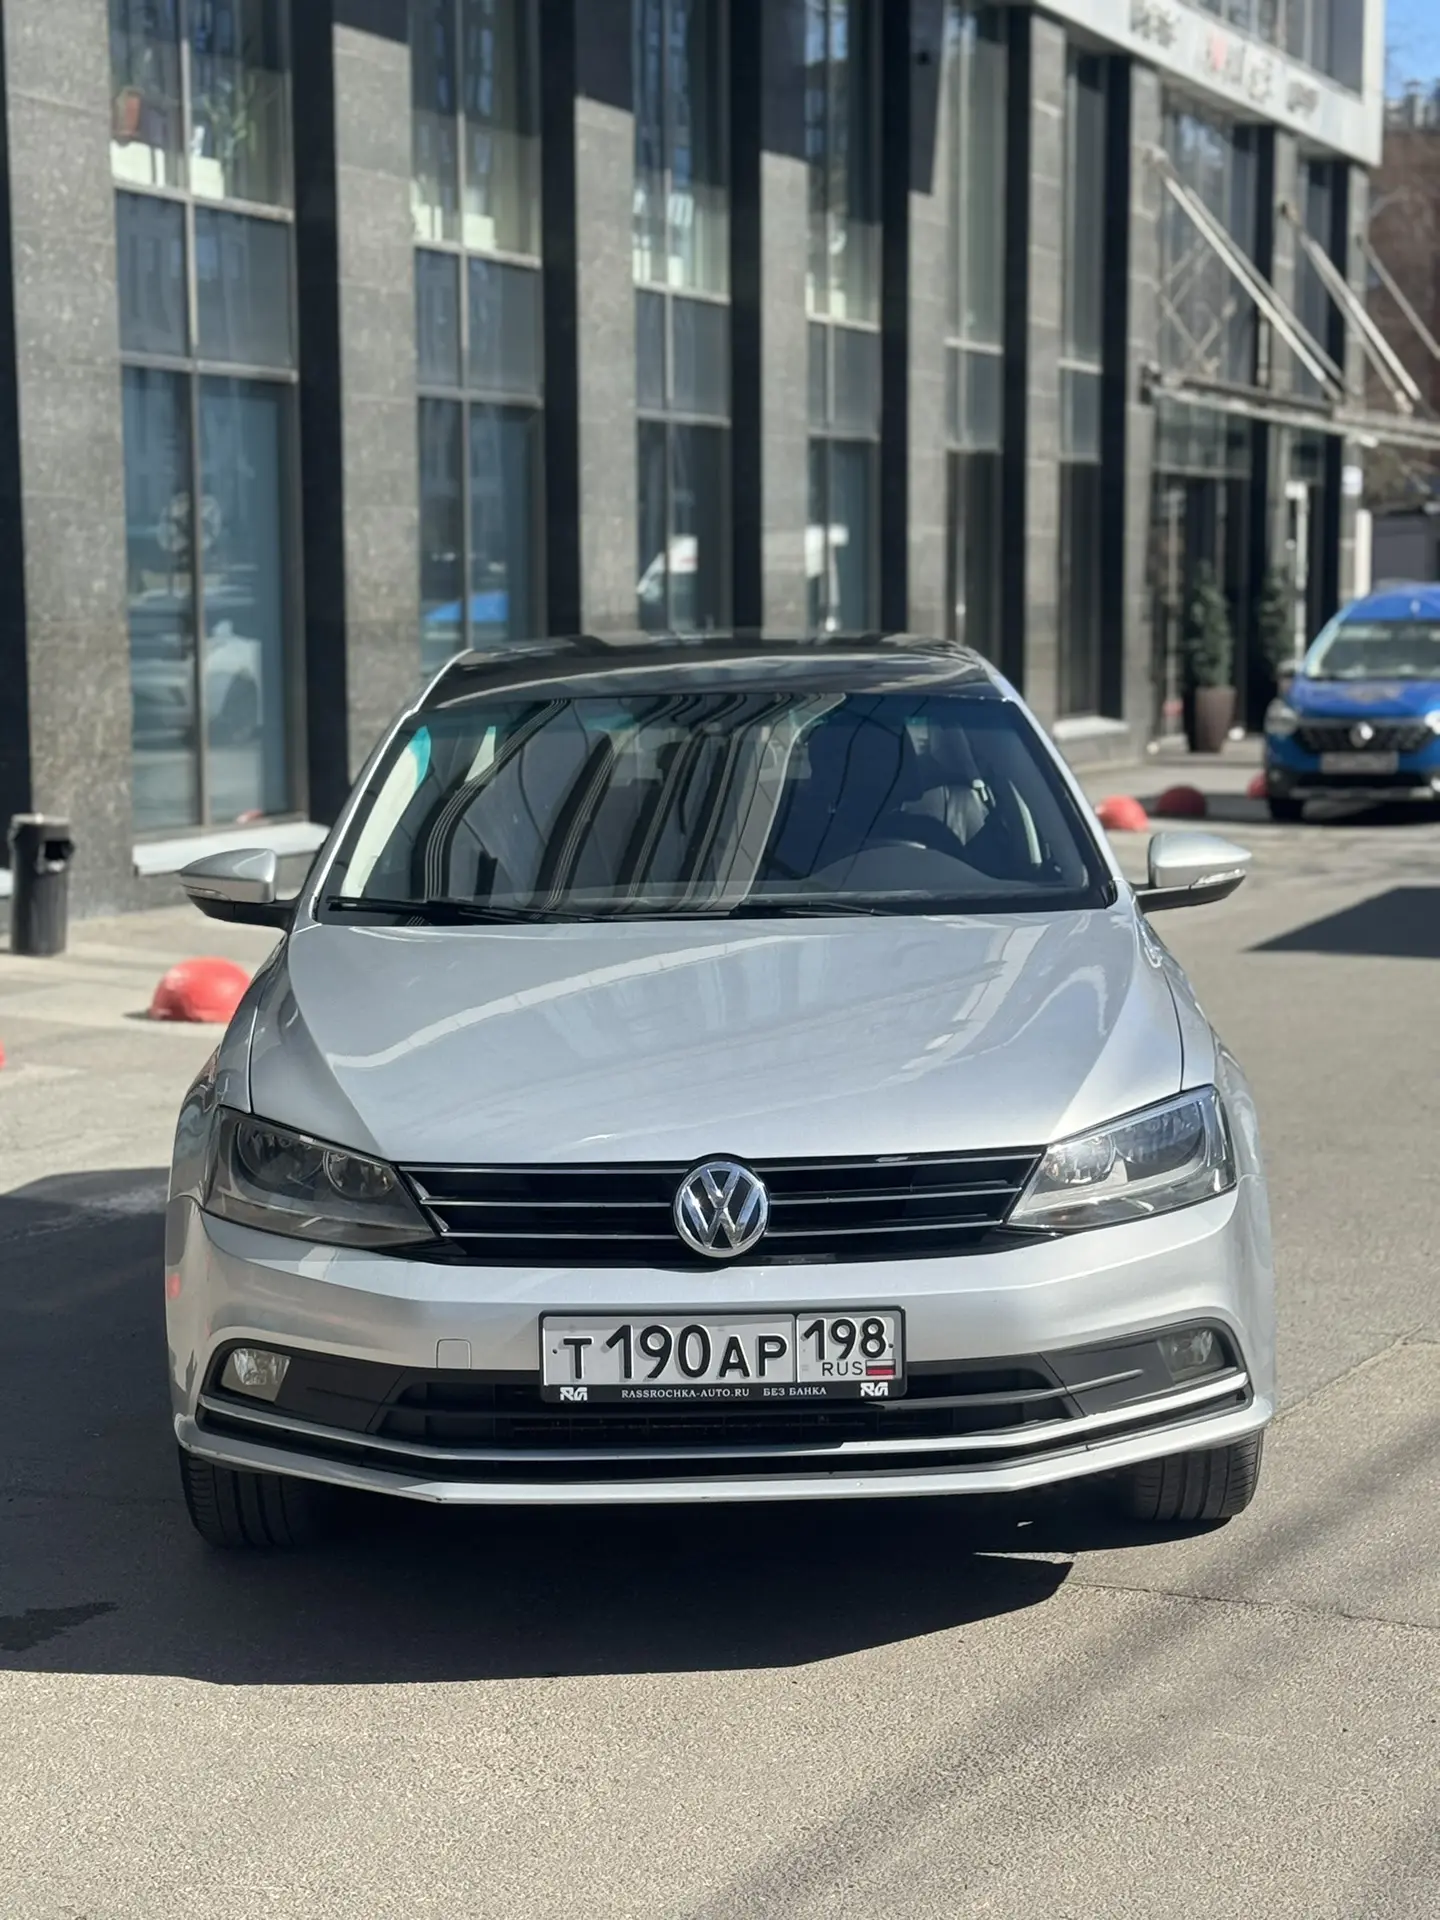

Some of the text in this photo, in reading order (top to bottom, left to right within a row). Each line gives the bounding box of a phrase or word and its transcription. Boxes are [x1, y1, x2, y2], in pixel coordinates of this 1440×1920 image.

[676, 1163, 767, 1256] VW
[803, 1317, 887, 1361] 198
[821, 1361, 863, 1377] RUS
[621, 1388, 750, 1399] RASSROCHKA-AUTO.RU
[763, 1386, 827, 1397] БЕЗ БАНКА
